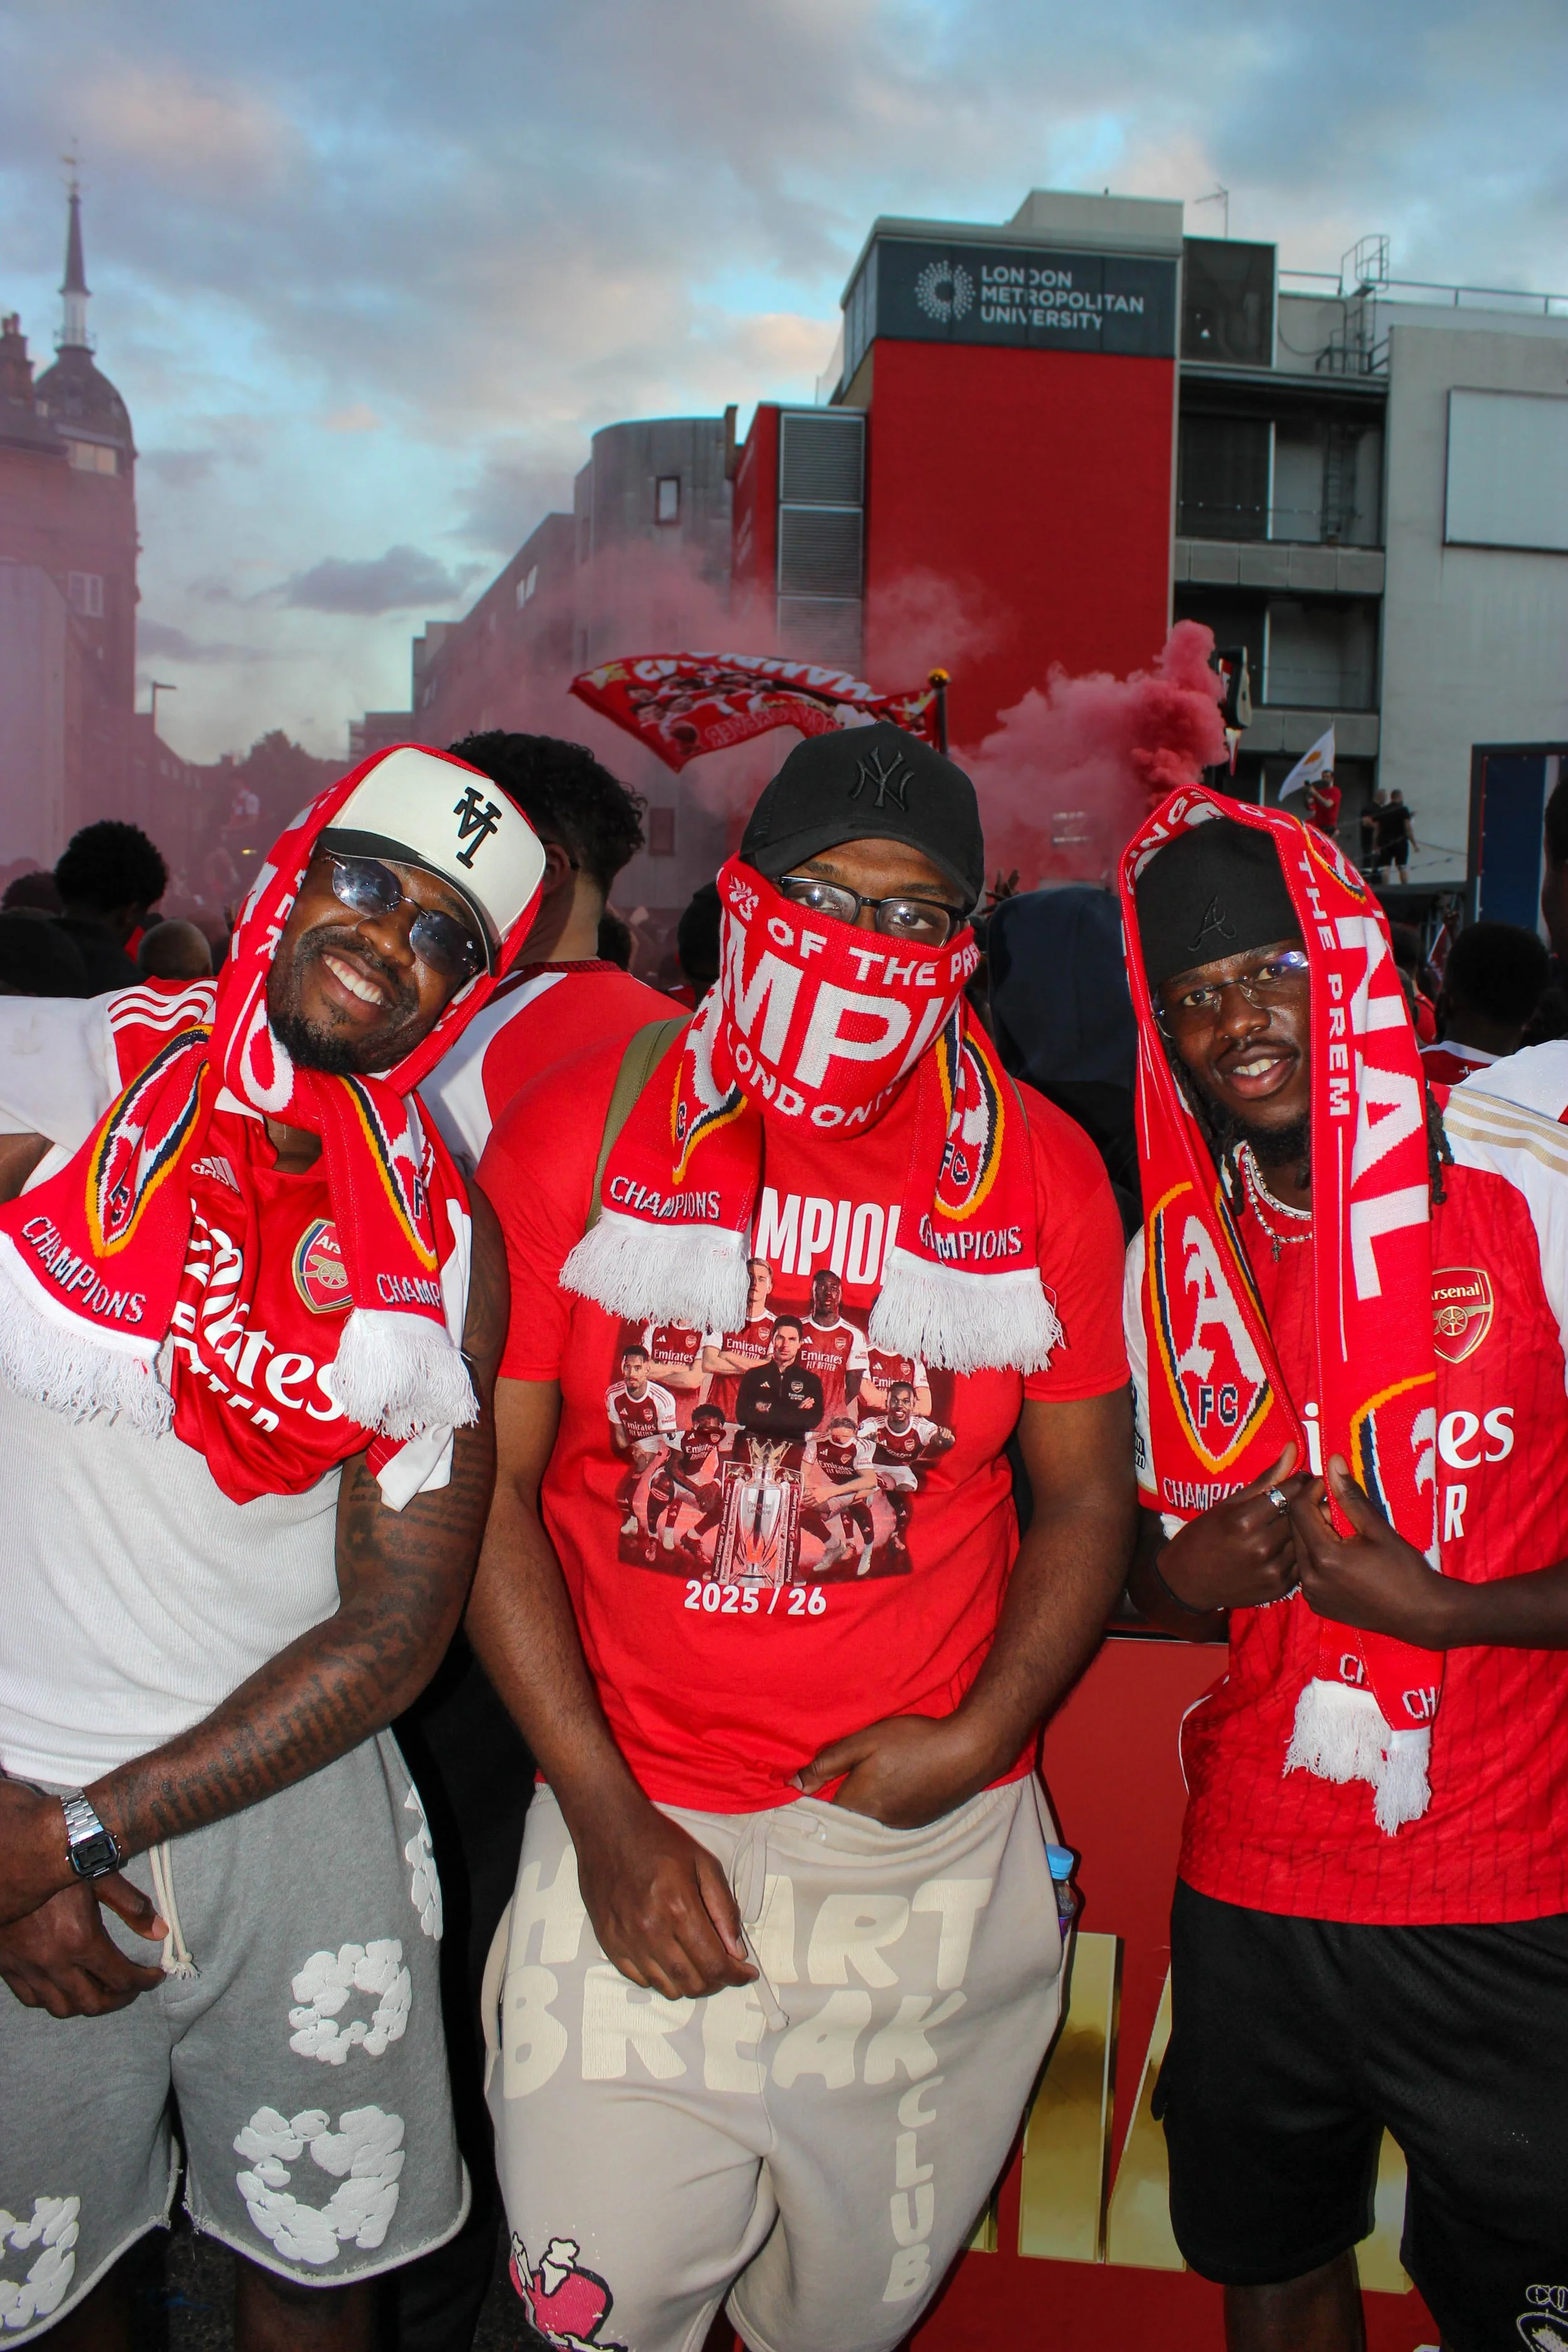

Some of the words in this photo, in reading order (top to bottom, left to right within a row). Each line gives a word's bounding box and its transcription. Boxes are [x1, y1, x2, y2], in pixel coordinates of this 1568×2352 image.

[981, 265, 1072, 289] LONDON
[981, 287, 1144, 314] METROPOLITAN
[981, 307, 1103, 331] UNIVERSITY
[767, 917, 827, 960] OF
[849, 946, 940, 986] THE
[950, 945, 983, 982] PRE
[1299, 850, 1335, 951] THE
[1328, 974, 1350, 1117] PREM
[610, 1175, 721, 1219] CHAMPIONS
[21, 1216, 147, 1323] CHAMPIONS
[377, 1273, 441, 1308] CHAMP
[654, 1349, 694, 1364] Emirates
[727, 1338, 766, 1355] Emirates
[801, 1350, 844, 1365] Emirates
[807, 1360, 817, 1369] FLY
[817, 1362, 837, 1372] BETTER
[1199, 1384, 1238, 1428] FC
[818, 1460, 854, 1473] Emirates
[508, 1845, 993, 1991] HART
[502, 1965, 967, 2099] BREAK
[882, 2076, 943, 2303] CLUB
